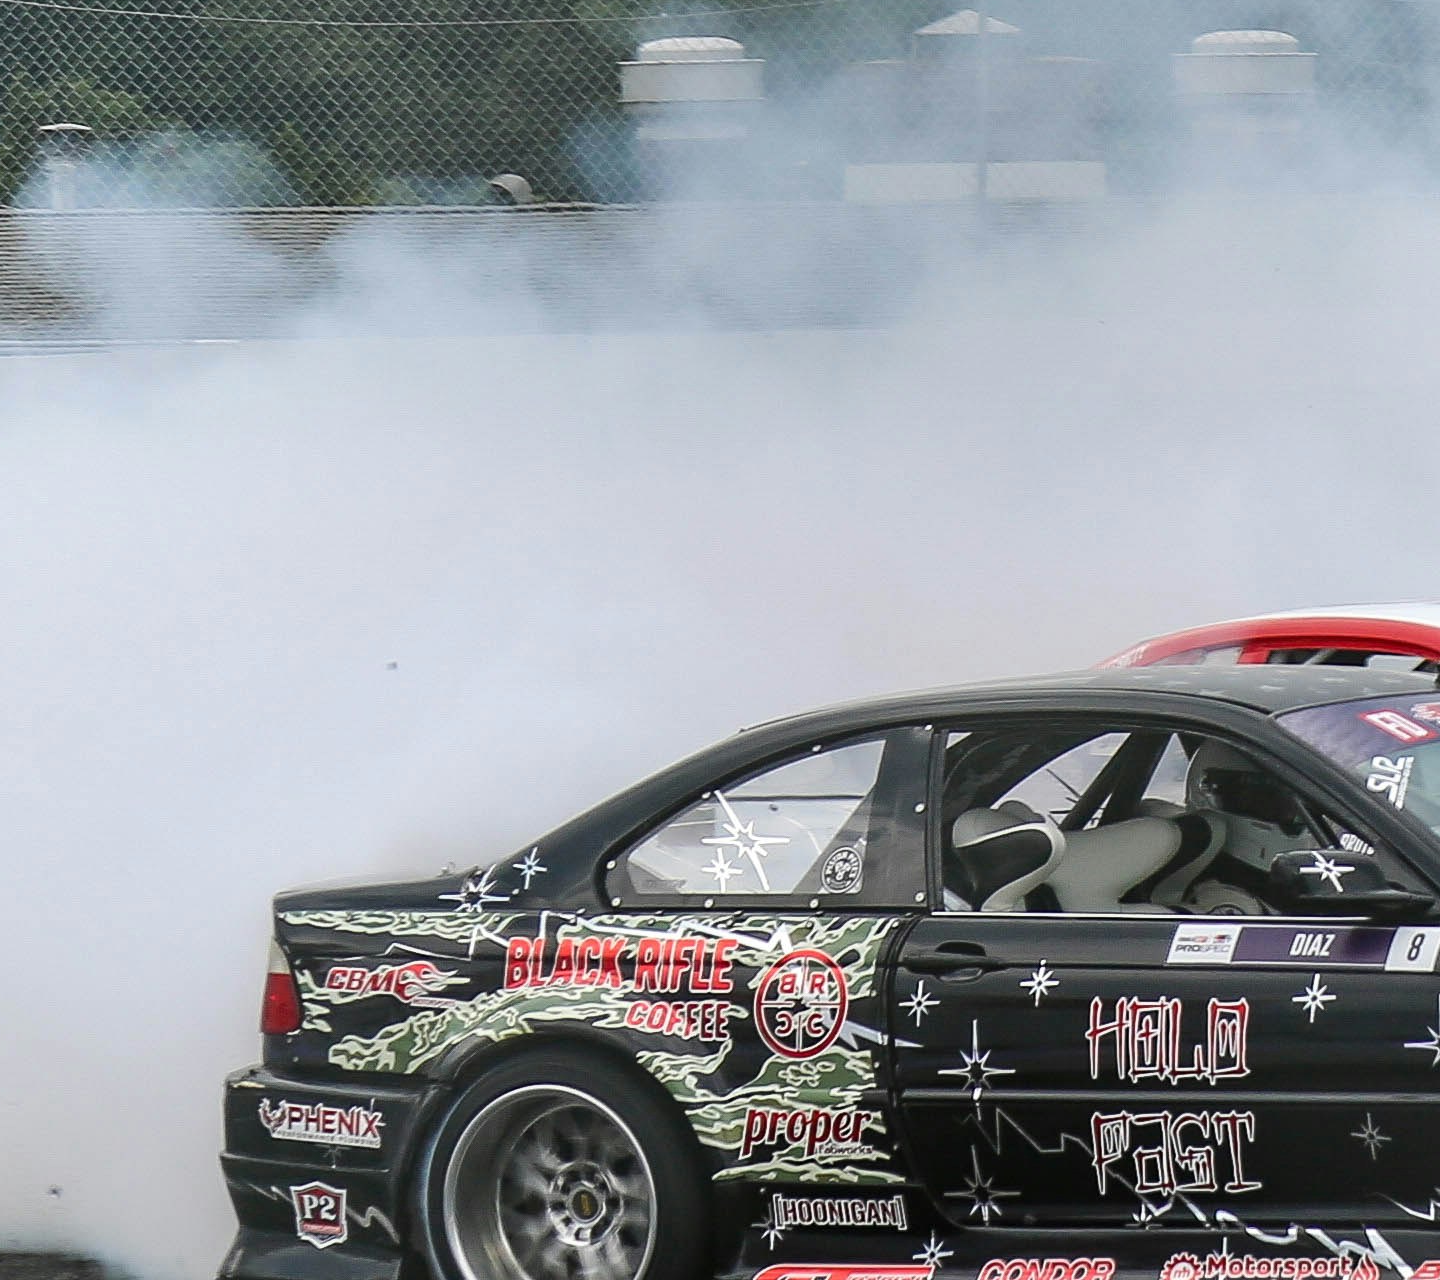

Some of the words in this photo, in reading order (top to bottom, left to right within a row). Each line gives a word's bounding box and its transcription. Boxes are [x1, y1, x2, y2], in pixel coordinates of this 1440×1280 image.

[1289, 932, 1337, 957] DIAZ
[1406, 932, 1426, 962] 8
[505, 936, 628, 991] BLACK
[633, 936, 738, 993] RIFLE
[625, 1000, 733, 1041] COFFEE
[287, 1106, 380, 1138] PHENIX
[738, 1107, 874, 1160] proper
[302, 1194, 337, 1221] P2
